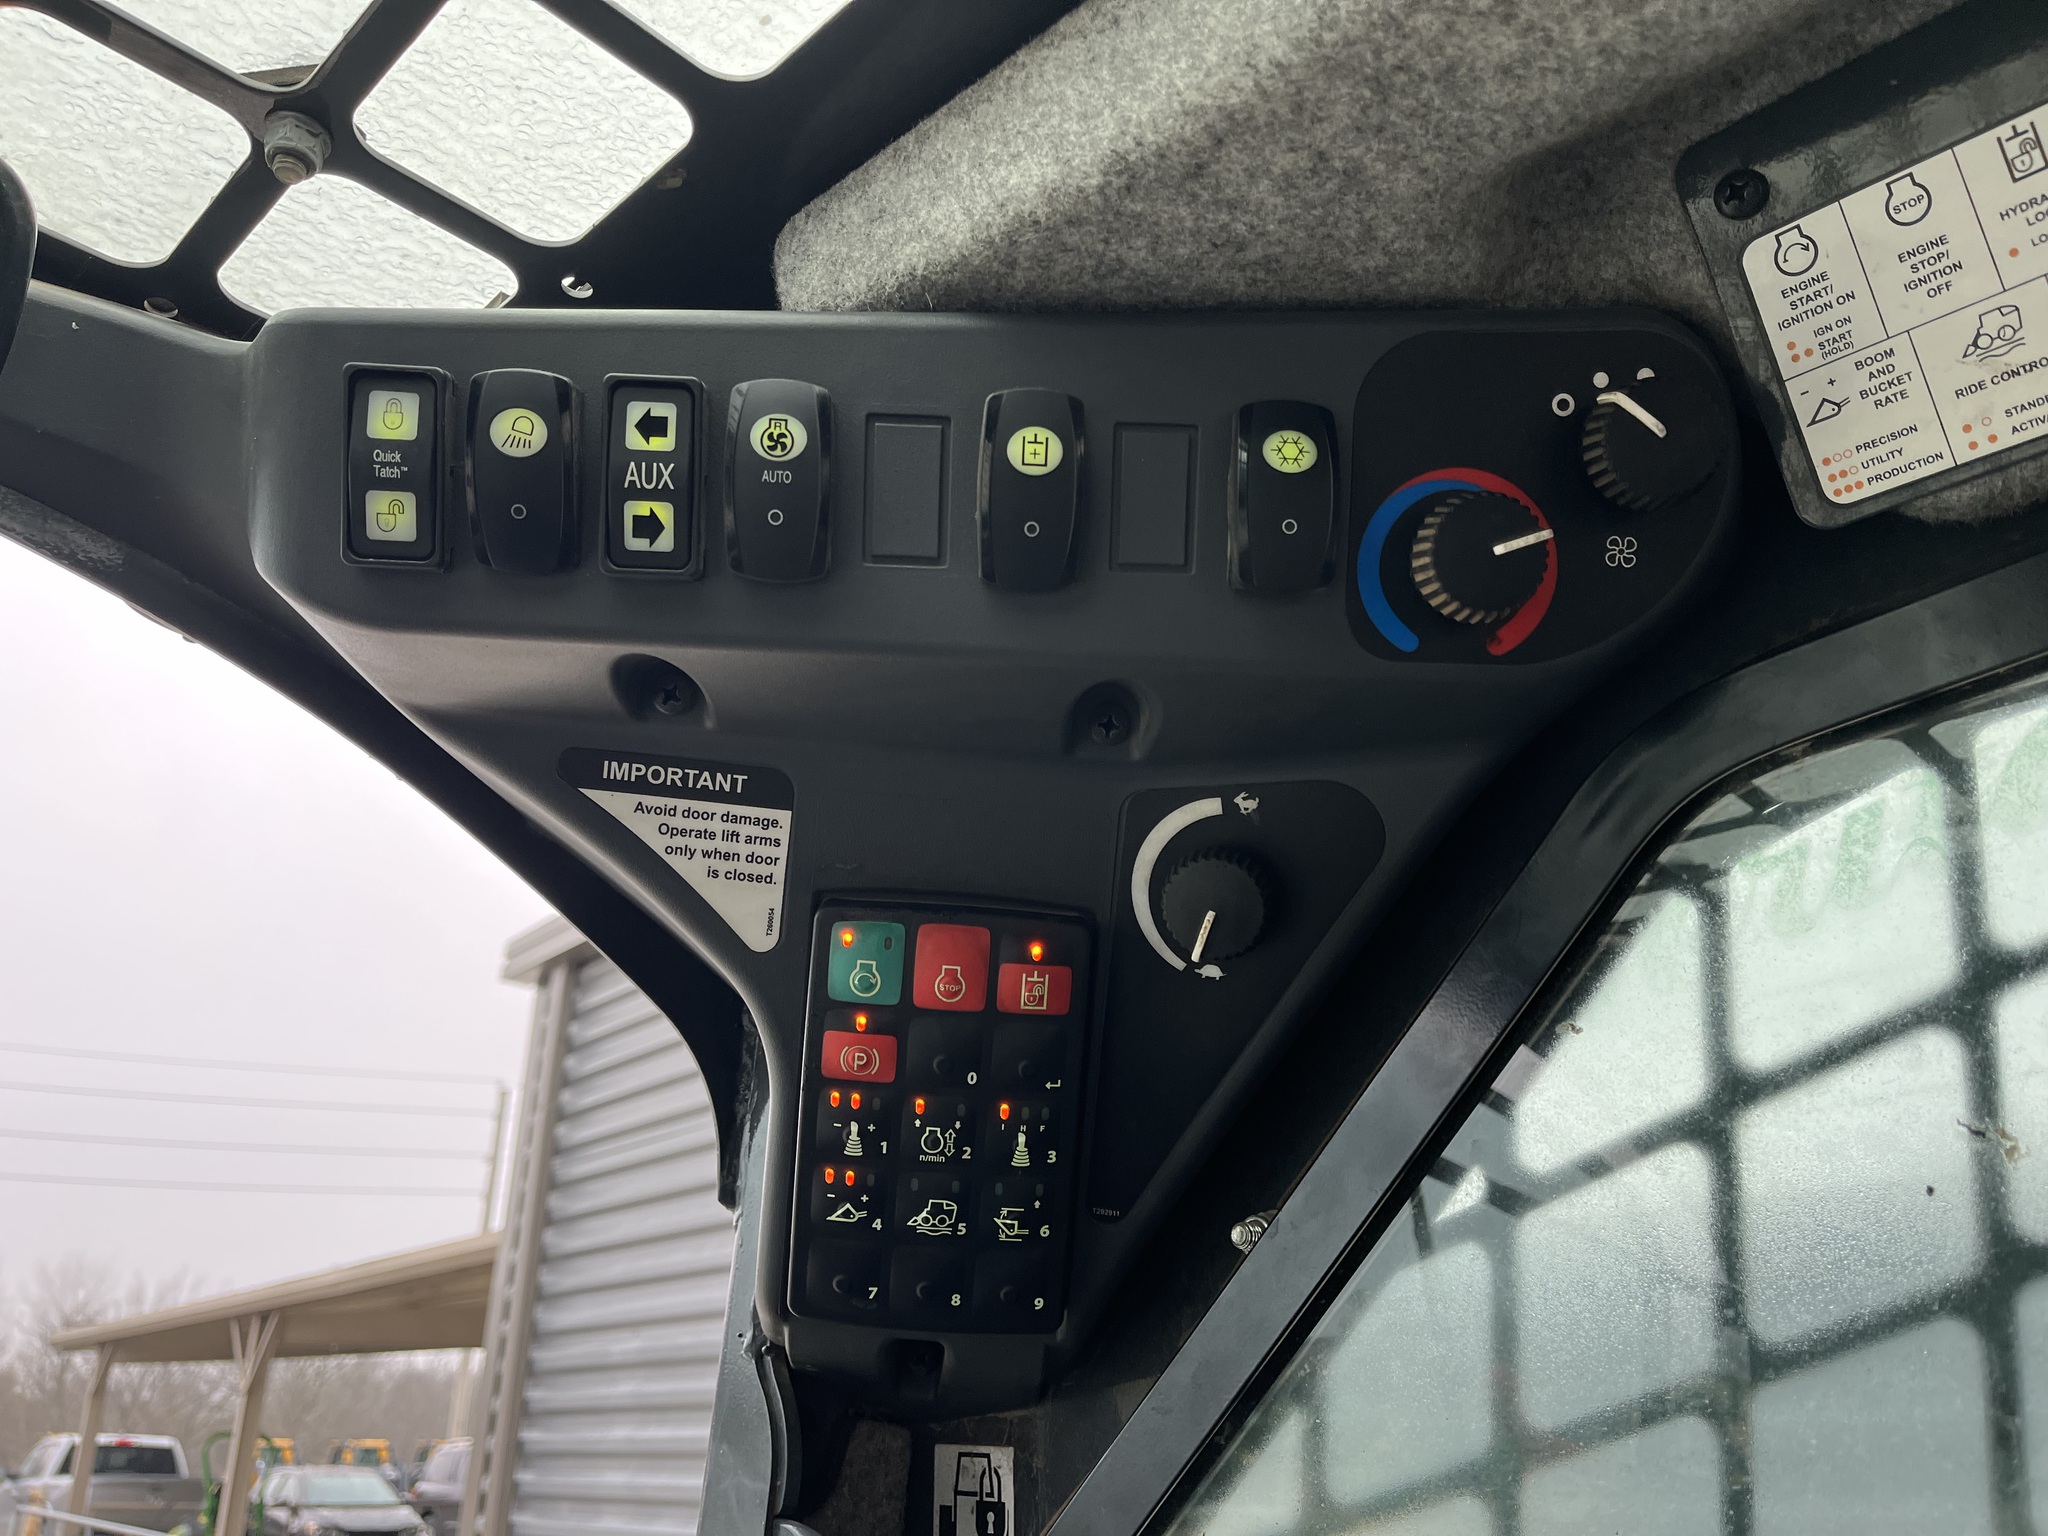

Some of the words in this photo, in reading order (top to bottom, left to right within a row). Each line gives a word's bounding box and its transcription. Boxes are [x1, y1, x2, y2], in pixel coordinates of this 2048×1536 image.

[1892, 194, 1925, 215] STOP
[2025, 209, 2048, 226] LO
[1897, 234, 1950, 263] ENGINE
[1910, 249, 1950, 274] STOP/
[1780, 271, 1830, 299] ENGINE
[1903, 260, 1963, 293] IGNITION
[1789, 283, 1834, 311] START/
[1926, 280, 1953, 299] OFF
[1777, 300, 1834, 332] IGNITION
[1836, 290, 1856, 306] ON
[1813, 323, 1833, 338] IGN
[1835, 315, 1852, 329] ON
[1818, 329, 1853, 351] START
[1821, 340, 1855, 361] (HOLD)
[1854, 347, 1896, 371] BOOM
[1868, 363, 1896, 382] AND
[1954, 379, 1988, 400] RIDE
[1990, 356, 2048, 386] CONTRO
[1859, 371, 1913, 400] BUCKET
[1874, 388, 1910, 410] RATE
[774, 421, 782, 432] R
[2011, 414, 2048, 436] ACTIV
[1855, 423, 1919, 454] PRECISION
[373, 449, 402, 463] Quick
[1861, 447, 1904, 470] UTILITY
[624, 460, 675, 491] AUX
[761, 469, 792, 484] AUTO
[1866, 451, 1944, 486] PRODUCTION
[602, 760, 748, 794] IMPORTANT
[633, 801, 677, 818] Avoid
[681, 806, 717, 822] door
[720, 810, 784, 830] damage.
[657, 822, 717, 840] Operate
[721, 829, 740, 844] lift
[744, 834, 782, 848] arms
[664, 844, 697, 860] only
[701, 849, 740, 863] when
[745, 854, 780, 866] door
[706, 866, 720, 879] is
[724, 868, 777, 885] closed.
[939, 983, 962, 992] STOP
[853, 1052, 867, 1071] P
[967, 1071, 978, 1085] 0
[1020, 1124, 1027, 1132] H
[880, 1141, 888, 1154] 1
[961, 1146, 972, 1160] 2
[1046, 1150, 1057, 1164] 3
[919, 1154, 946, 1163] n/min
[871, 1218, 883, 1231] 4
[956, 1223, 967, 1236] 5
[1039, 1225, 1050, 1238] 6
[868, 1286, 878, 1300] 7
[950, 1293, 962, 1307] 8
[1034, 1297, 1045, 1310] 9
